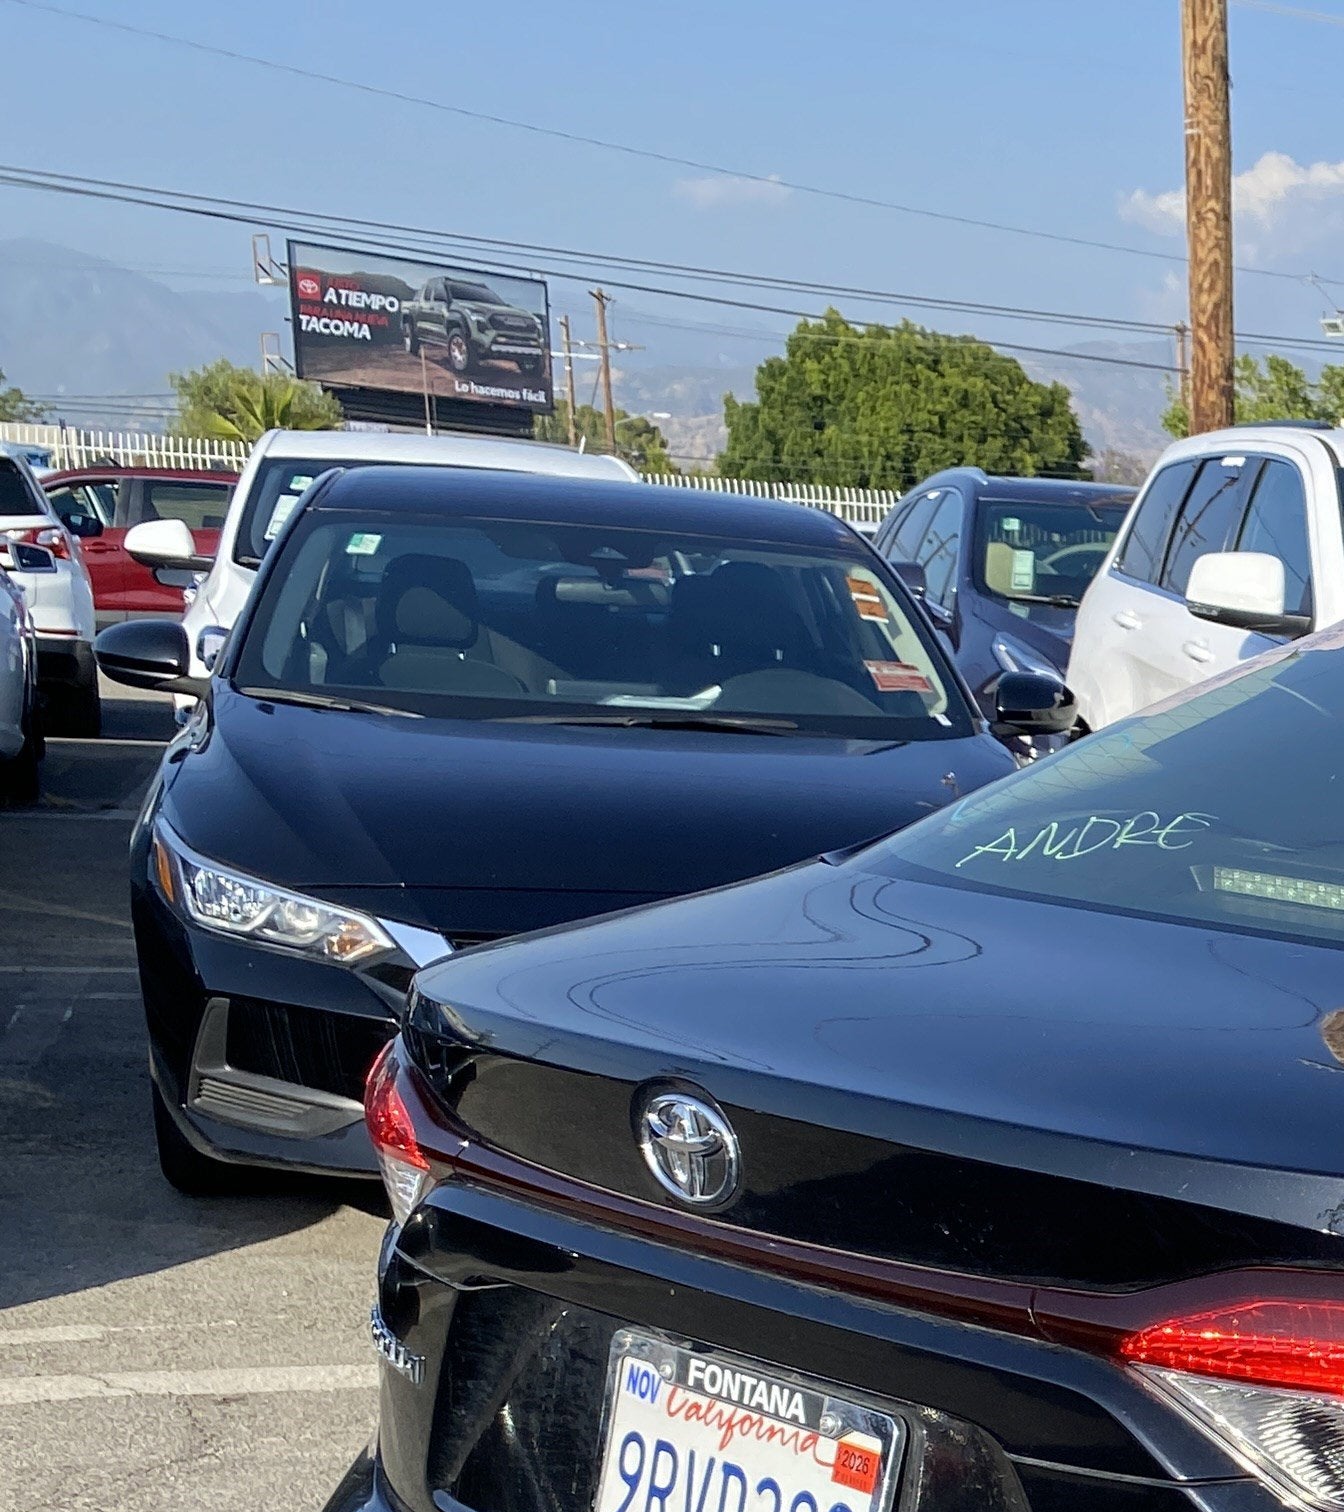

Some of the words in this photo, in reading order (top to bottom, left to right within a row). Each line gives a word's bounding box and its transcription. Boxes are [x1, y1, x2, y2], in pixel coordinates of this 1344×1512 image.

[323, 287, 338, 305] A
[338, 288, 400, 313] TIEMPO
[299, 314, 372, 341] TACOMA
[454, 380, 469, 393] Lo
[470, 381, 521, 400] hacemos
[954, 810, 1220, 869] ANDRE
[626, 1362, 662, 1405] NOV
[687, 1357, 806, 1425] FONTANA
[665, 1384, 836, 1468] California
[841, 1449, 871, 1476] 2026
